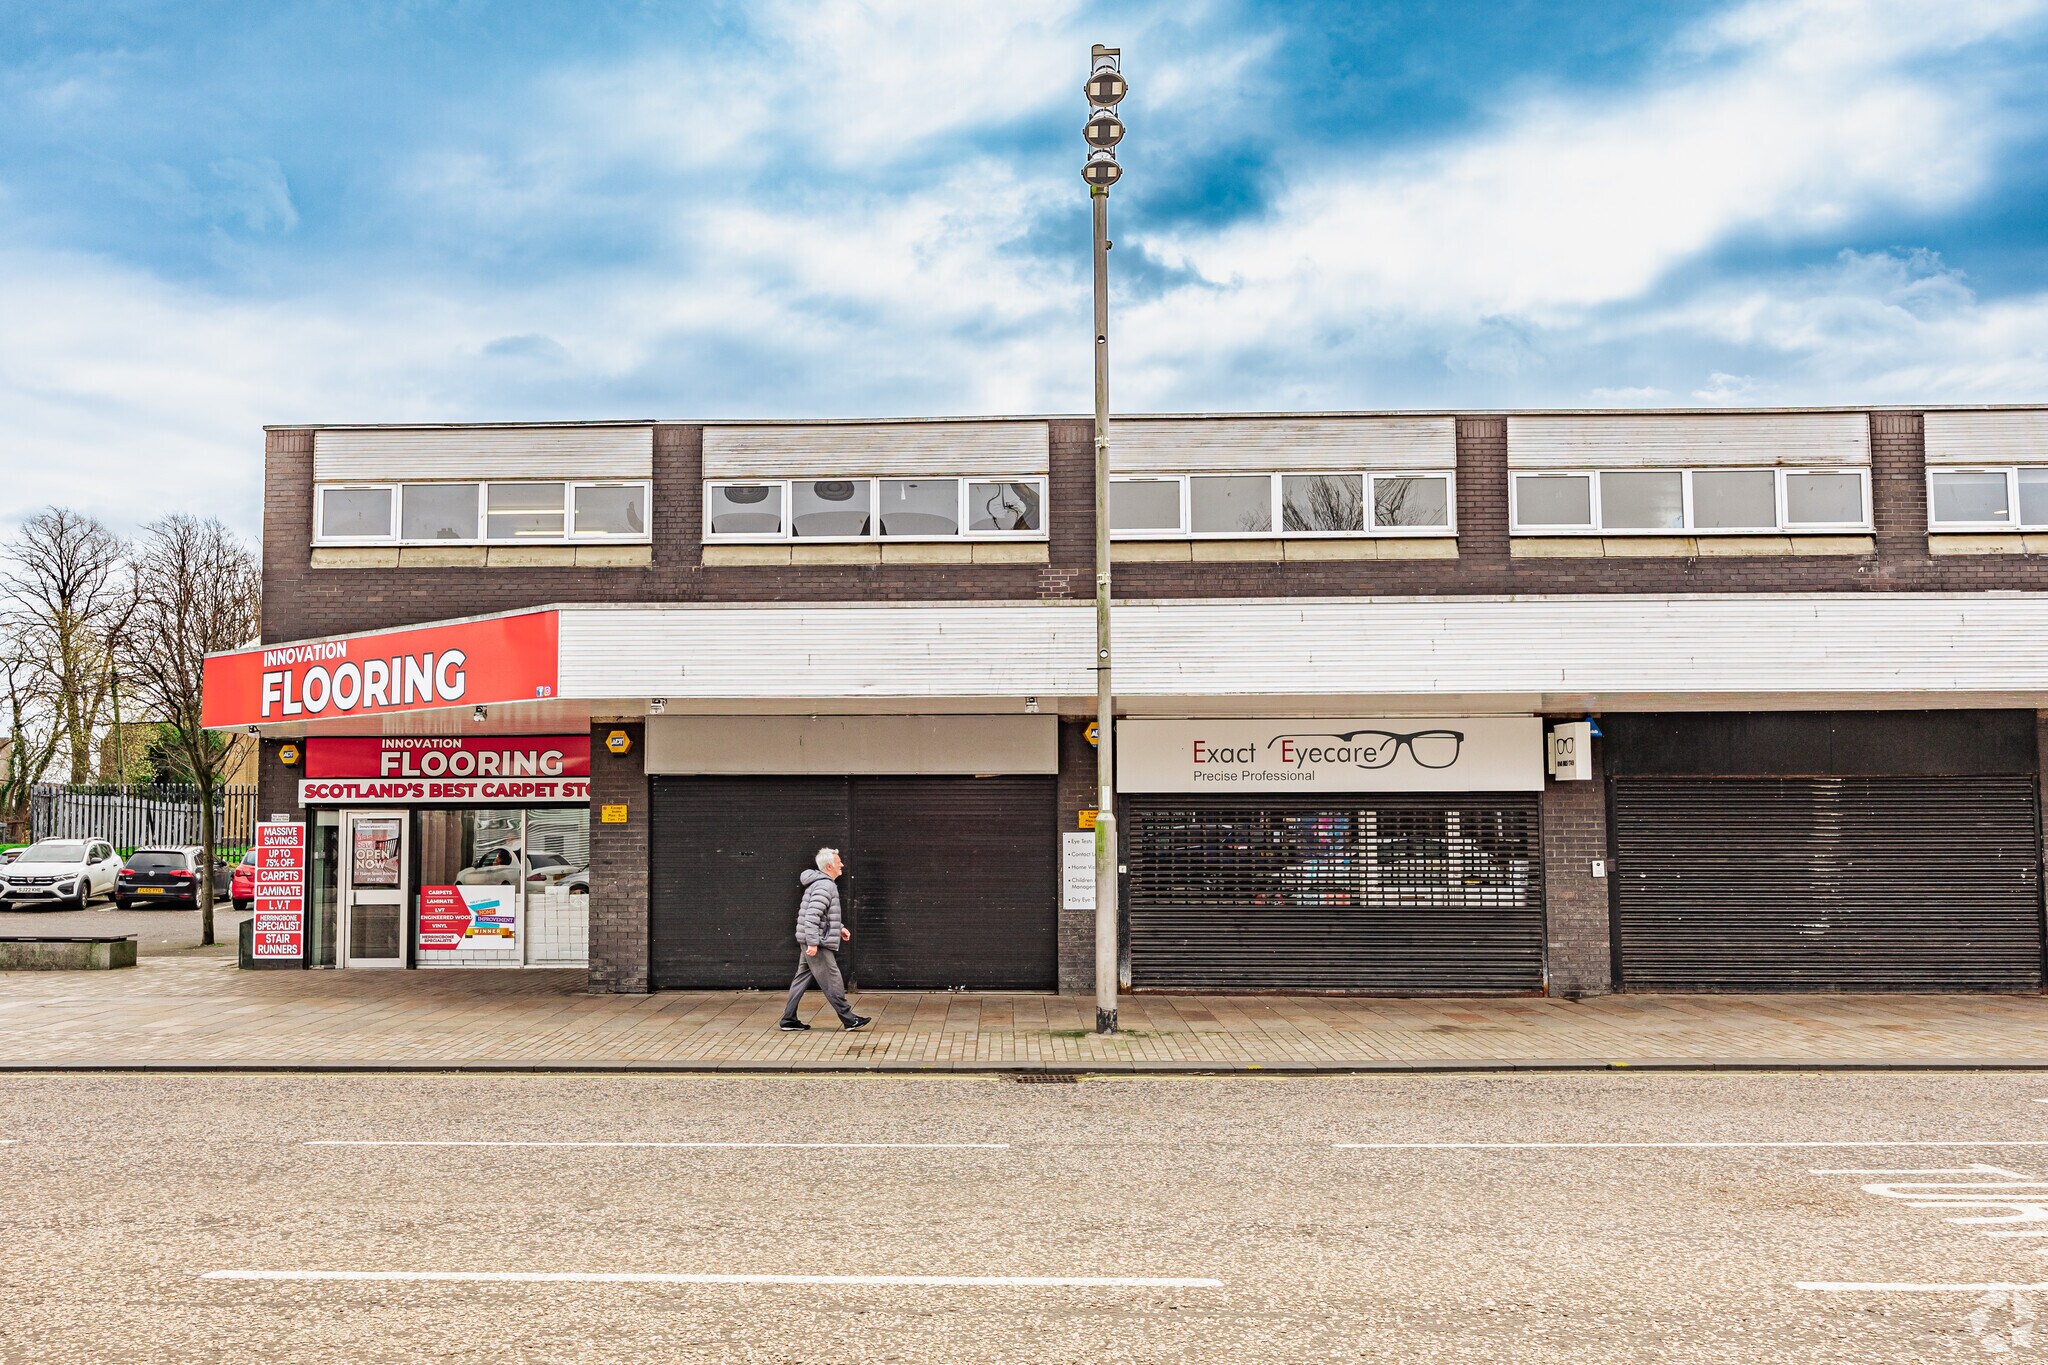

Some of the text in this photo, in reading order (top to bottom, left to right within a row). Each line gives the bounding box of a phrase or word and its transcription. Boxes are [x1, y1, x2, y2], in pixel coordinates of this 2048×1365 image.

[264, 641, 347, 667] INNOVATION
[261, 648, 467, 718] FLOORING
[381, 738, 462, 749] INNOVATION
[611, 738, 624, 746] ADT
[1193, 740, 1377, 769] Exact Eyecare
[380, 750, 564, 777] FLOORING
[1193, 770, 1315, 781] Precise Professional
[304, 783, 590, 798] SCOTLAND'S BEST CARPET ST
[263, 827, 298, 836] MASSIVE
[264, 836, 298, 845] SAVINGS
[268, 849, 291, 858] UP TO
[356, 849, 390, 860] OPEN
[265, 858, 295, 867] 75% OFF
[356, 859, 386, 869] NOW
[260, 870, 299, 881] CARPETS
[257, 886, 301, 896] LAMINATE
[257, 921, 300, 931] SPECIALIST
[265, 934, 290, 943] STAIR
[257, 944, 298, 954] RUNNERS
